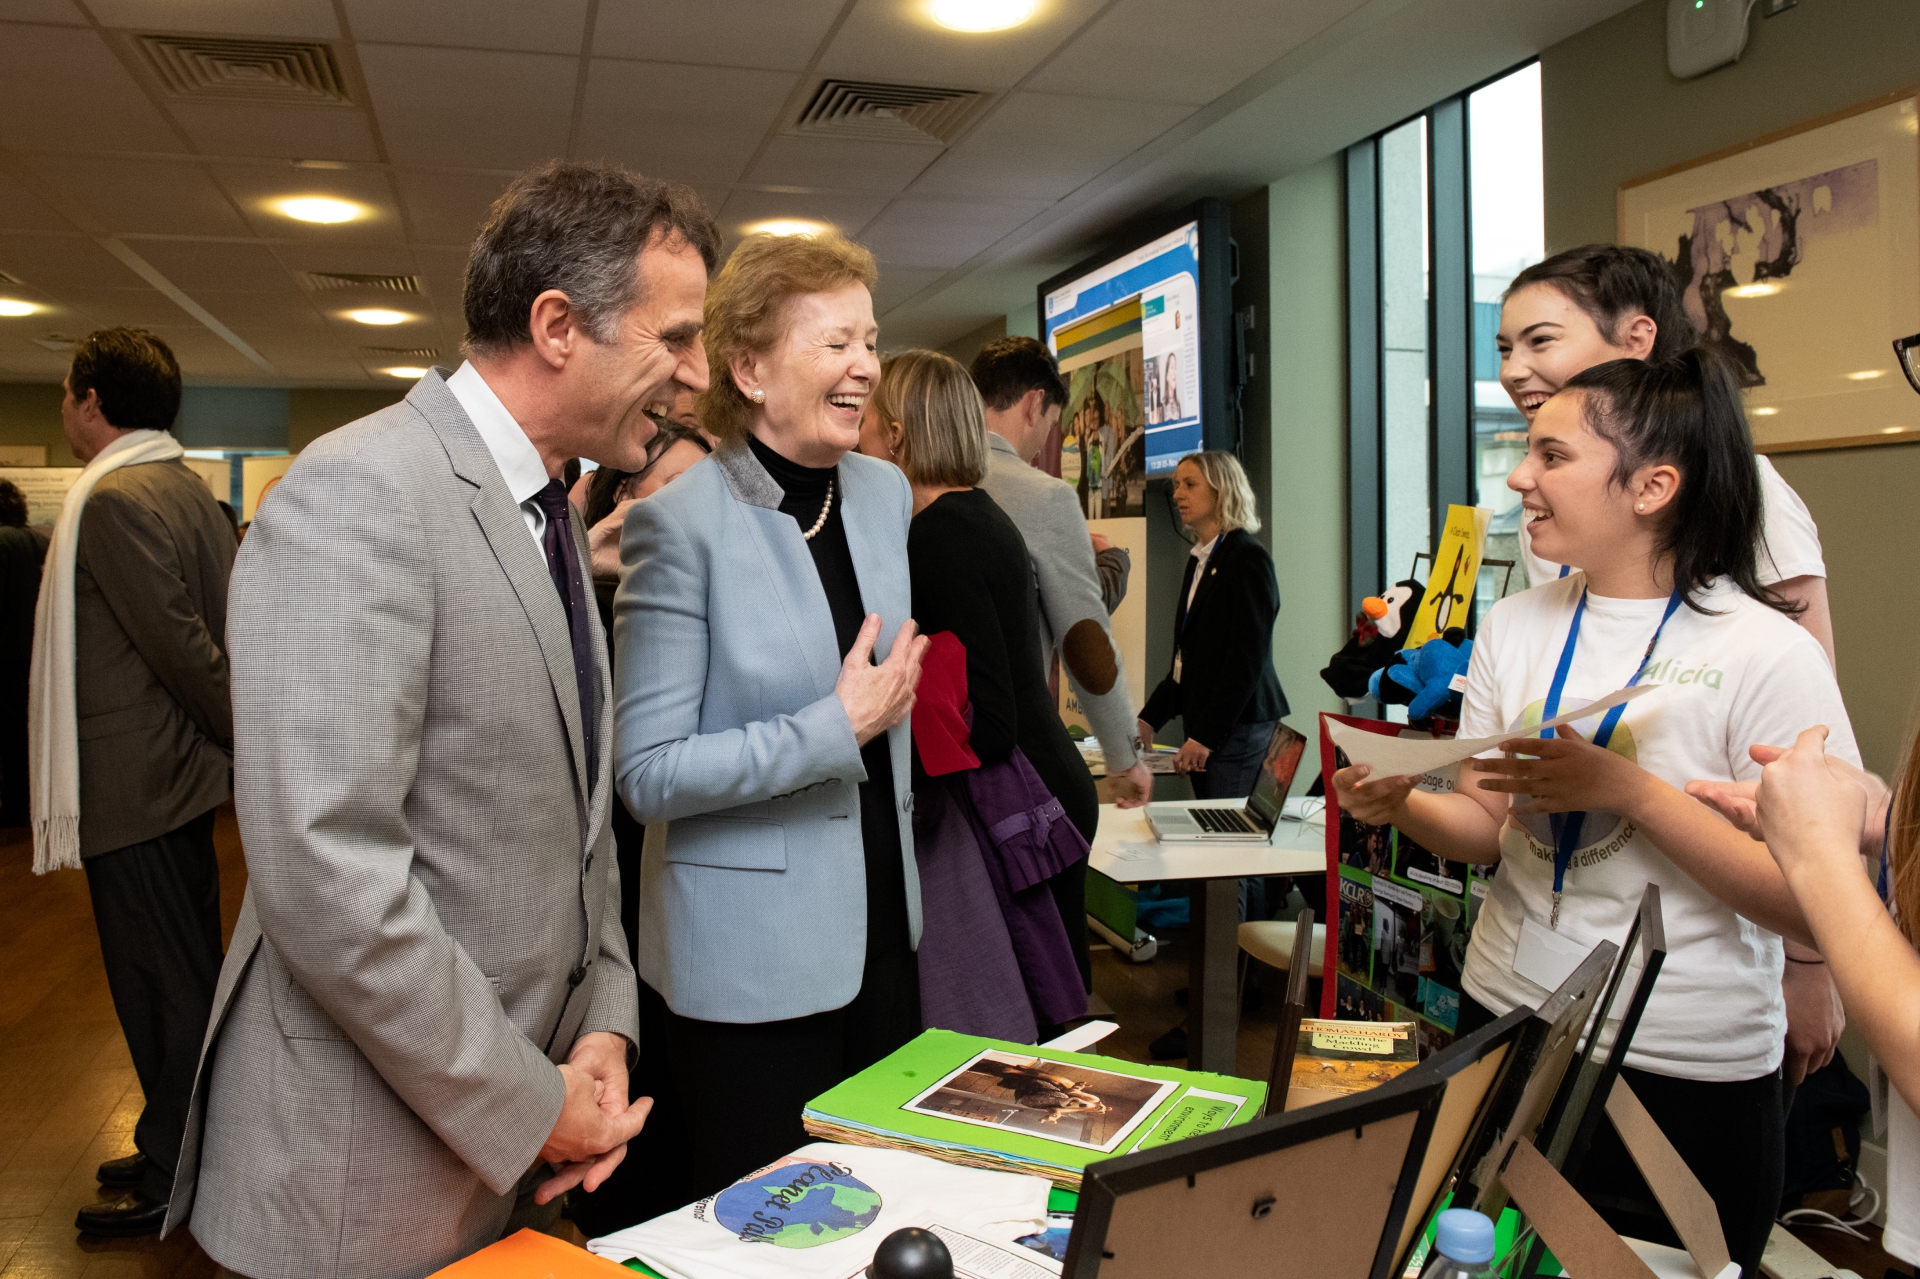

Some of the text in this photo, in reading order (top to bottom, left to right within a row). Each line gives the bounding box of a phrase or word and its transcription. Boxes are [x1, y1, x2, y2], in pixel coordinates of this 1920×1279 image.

[1639, 658, 1724, 690] Alicia
[1422, 774, 1444, 791] sage
[1573, 855, 1579, 868] a
[1580, 822, 1637, 868] difference
[1339, 877, 1365, 903] KCLR
[1304, 1026, 1405, 1038] THOMAS HARDY
[1325, 1038, 1380, 1049] Madding
[1333, 1044, 1372, 1052] Crowd
[1202, 1105, 1226, 1122] Ways
[1158, 1106, 1195, 1142] environment
[1196, 1121, 1212, 1129] to
[765, 1161, 853, 1212] Planet
